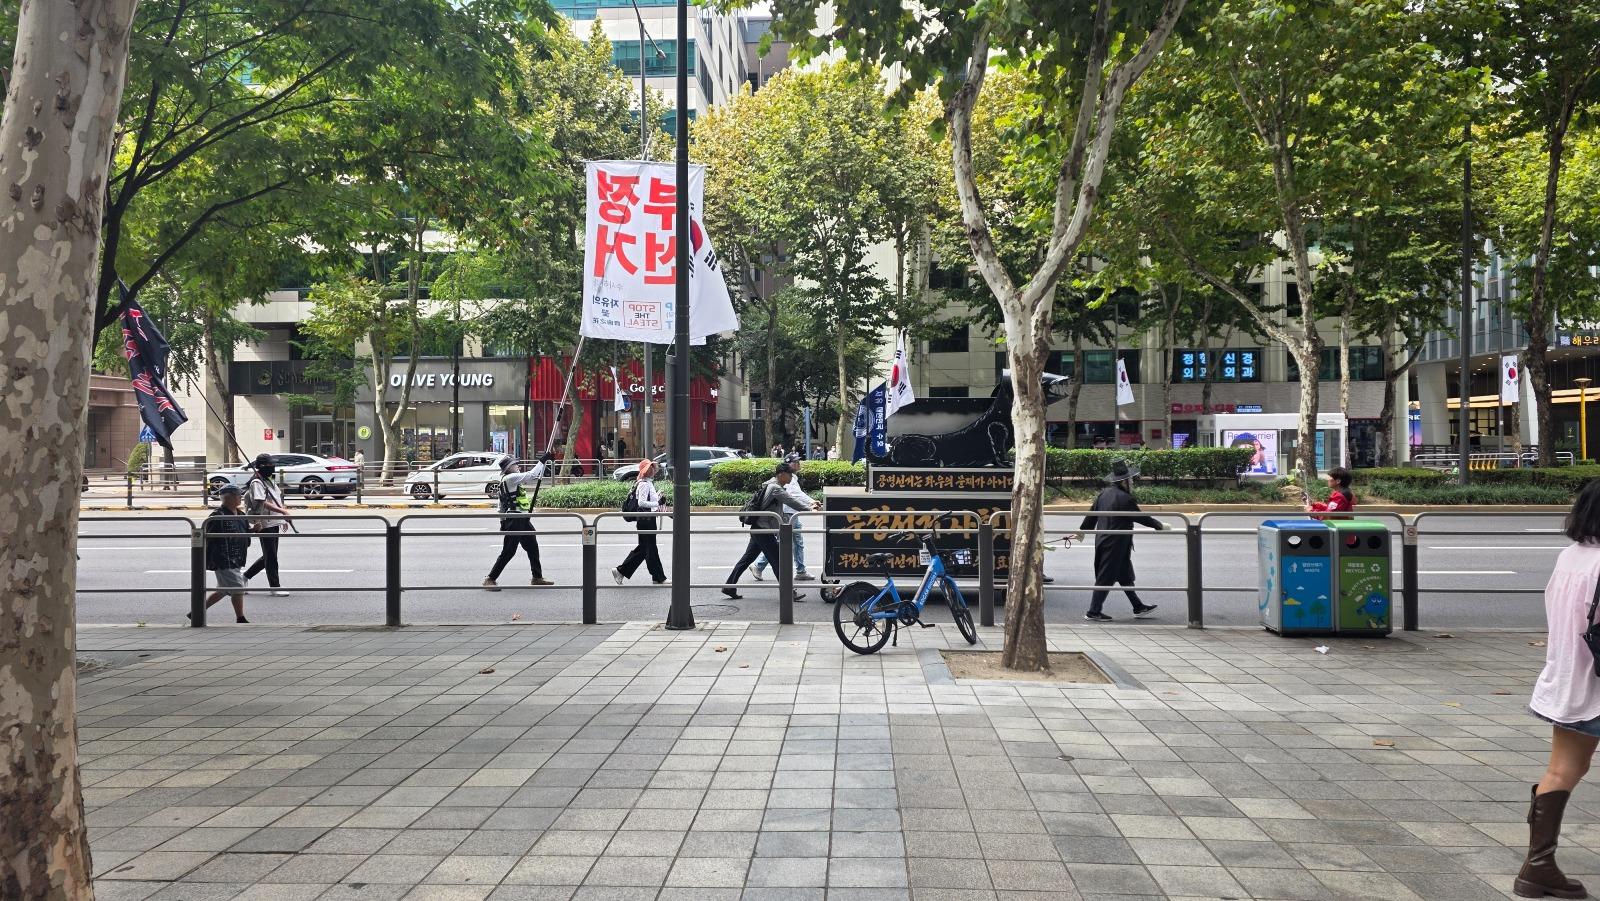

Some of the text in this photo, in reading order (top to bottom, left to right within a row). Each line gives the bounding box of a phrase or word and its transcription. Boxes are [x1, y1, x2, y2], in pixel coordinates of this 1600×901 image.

[1224, 352, 1253, 365] 신경
[1224, 366, 1254, 378] 외과
[630, 383, 657, 395] Gog
